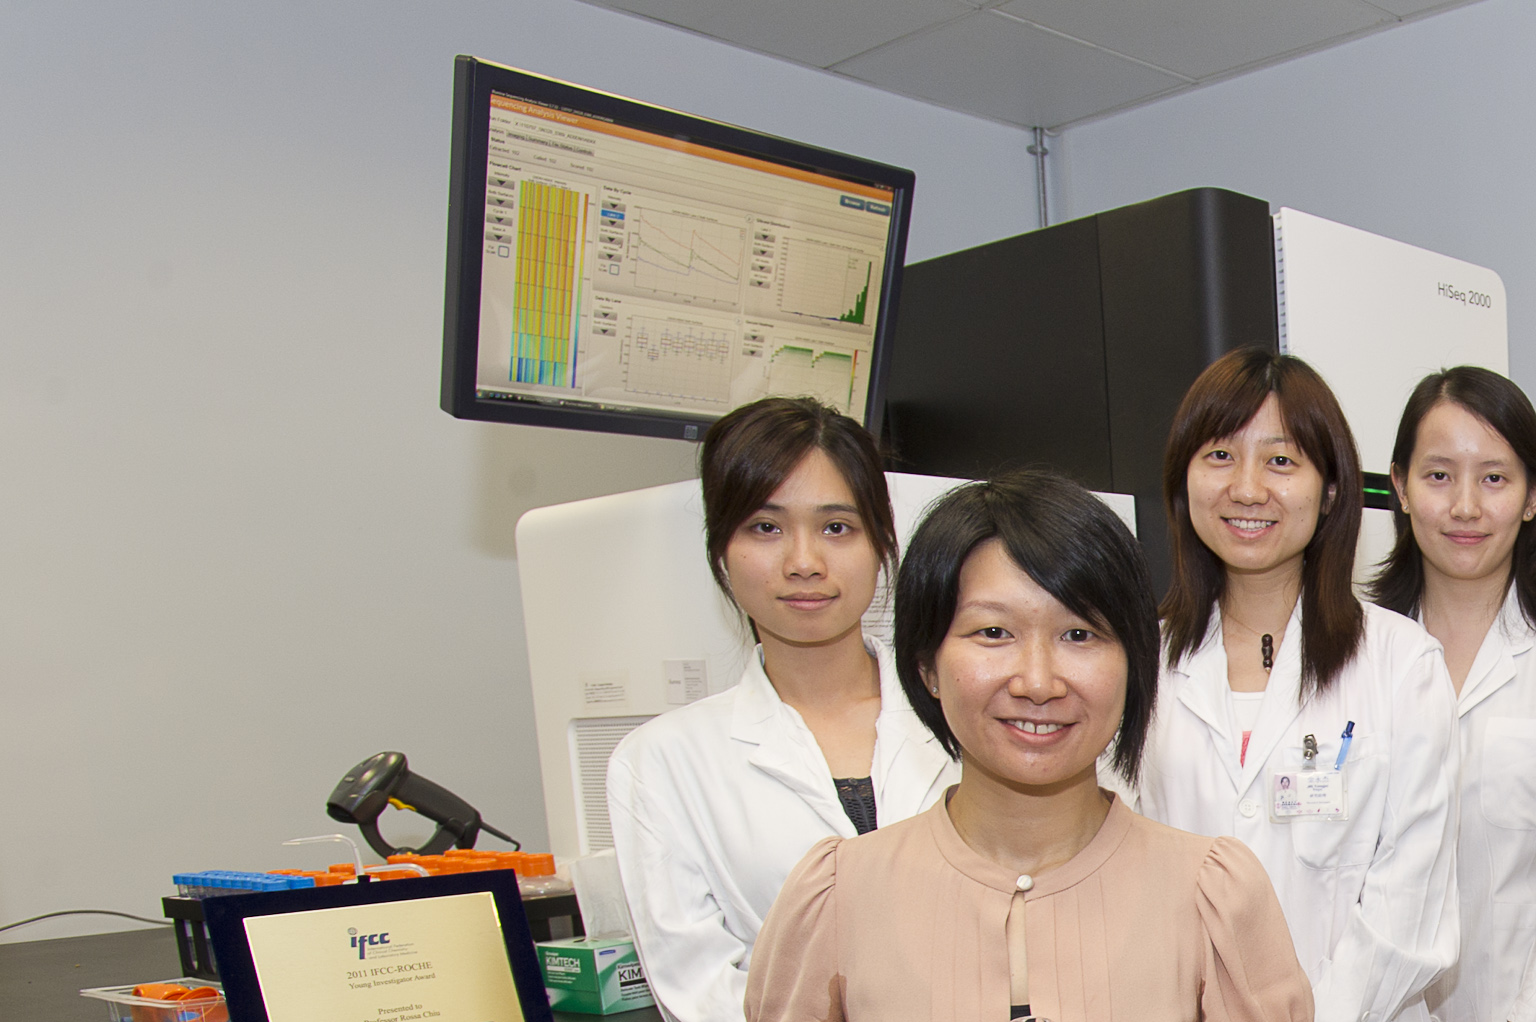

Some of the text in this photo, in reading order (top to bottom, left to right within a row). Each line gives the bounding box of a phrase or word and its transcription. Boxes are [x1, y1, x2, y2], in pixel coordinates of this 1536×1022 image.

[528, 106, 556, 118] Analysis
[555, 112, 579, 124] Viewer
[1438, 282, 1491, 308] HiSeq 2000
[347, 927, 390, 960] ifcc
[346, 961, 433, 979] 2011 IFCC-ROCHE
[546, 956, 580, 968] KIMTECH
[349, 972, 436, 990] Young Investigator Award
[378, 1004, 414, 1015] Presented
[422, 1010, 441, 1018] Chiu
